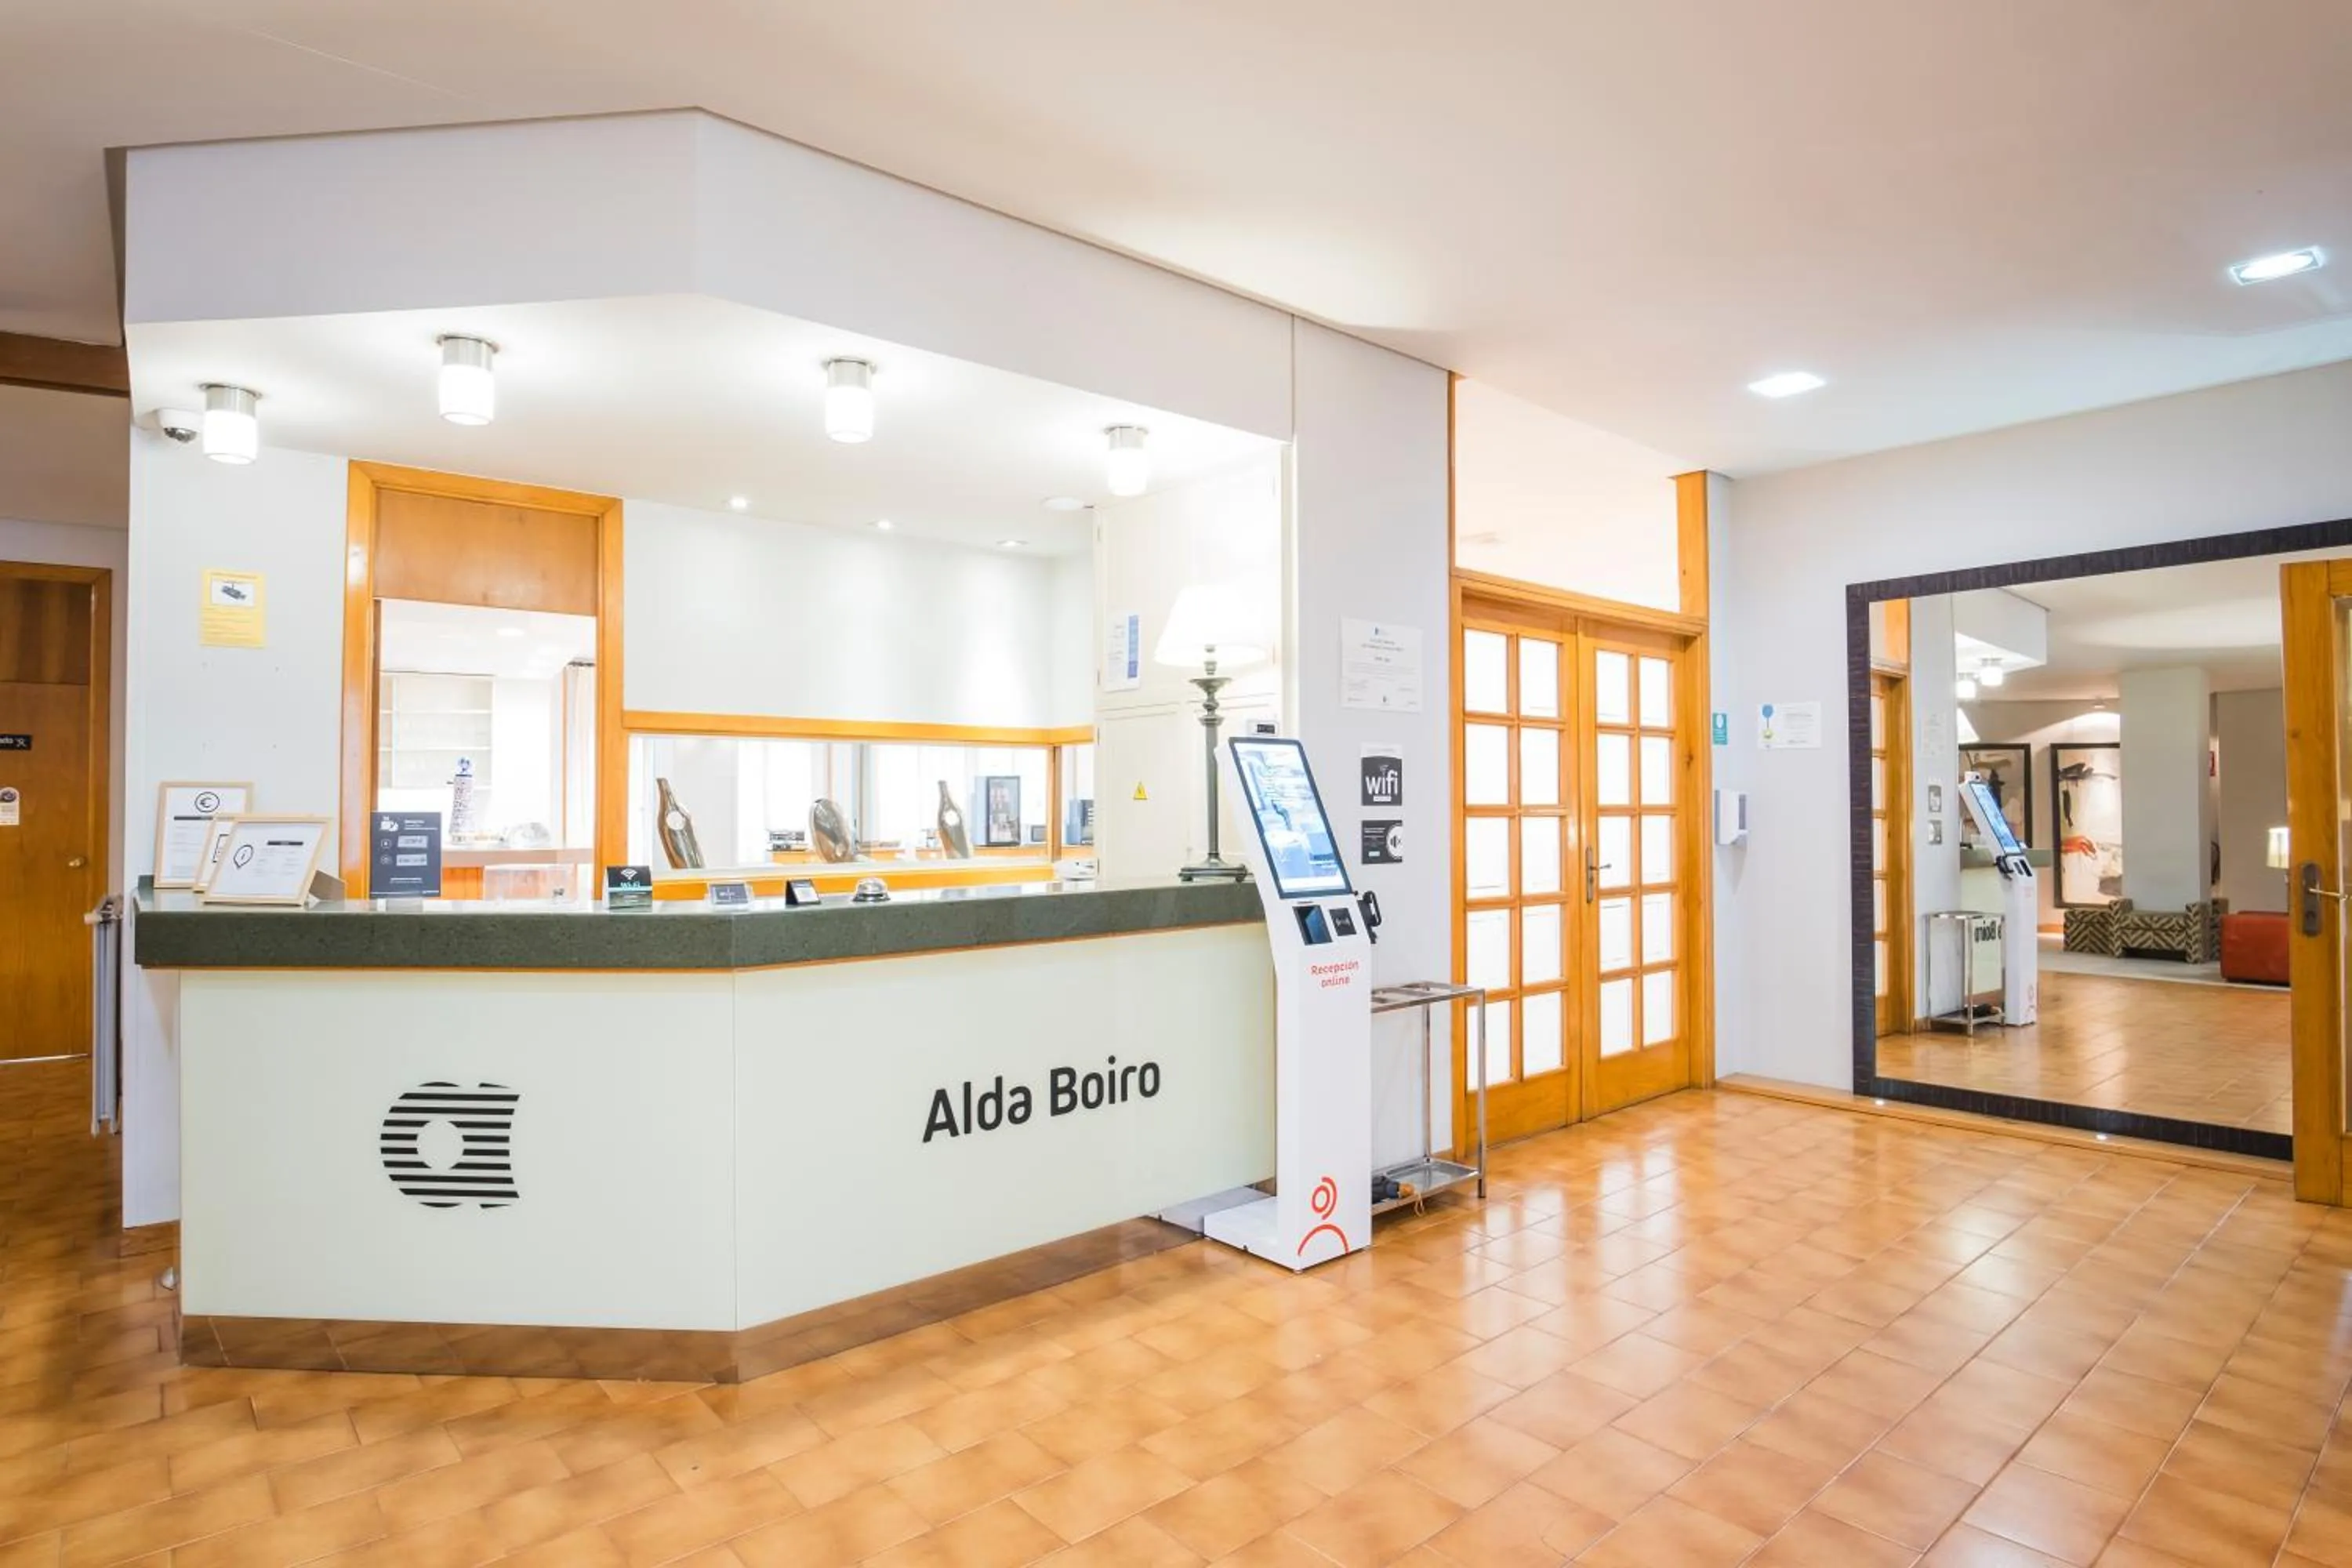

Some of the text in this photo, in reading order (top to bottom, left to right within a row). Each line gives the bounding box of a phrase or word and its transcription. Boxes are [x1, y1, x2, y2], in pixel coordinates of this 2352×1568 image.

[1365, 769, 1399, 796] wifi
[1311, 959, 1359, 976] Recepción
[1321, 975, 1351, 989] online
[922, 1054, 1160, 1143] Alda Boiro
